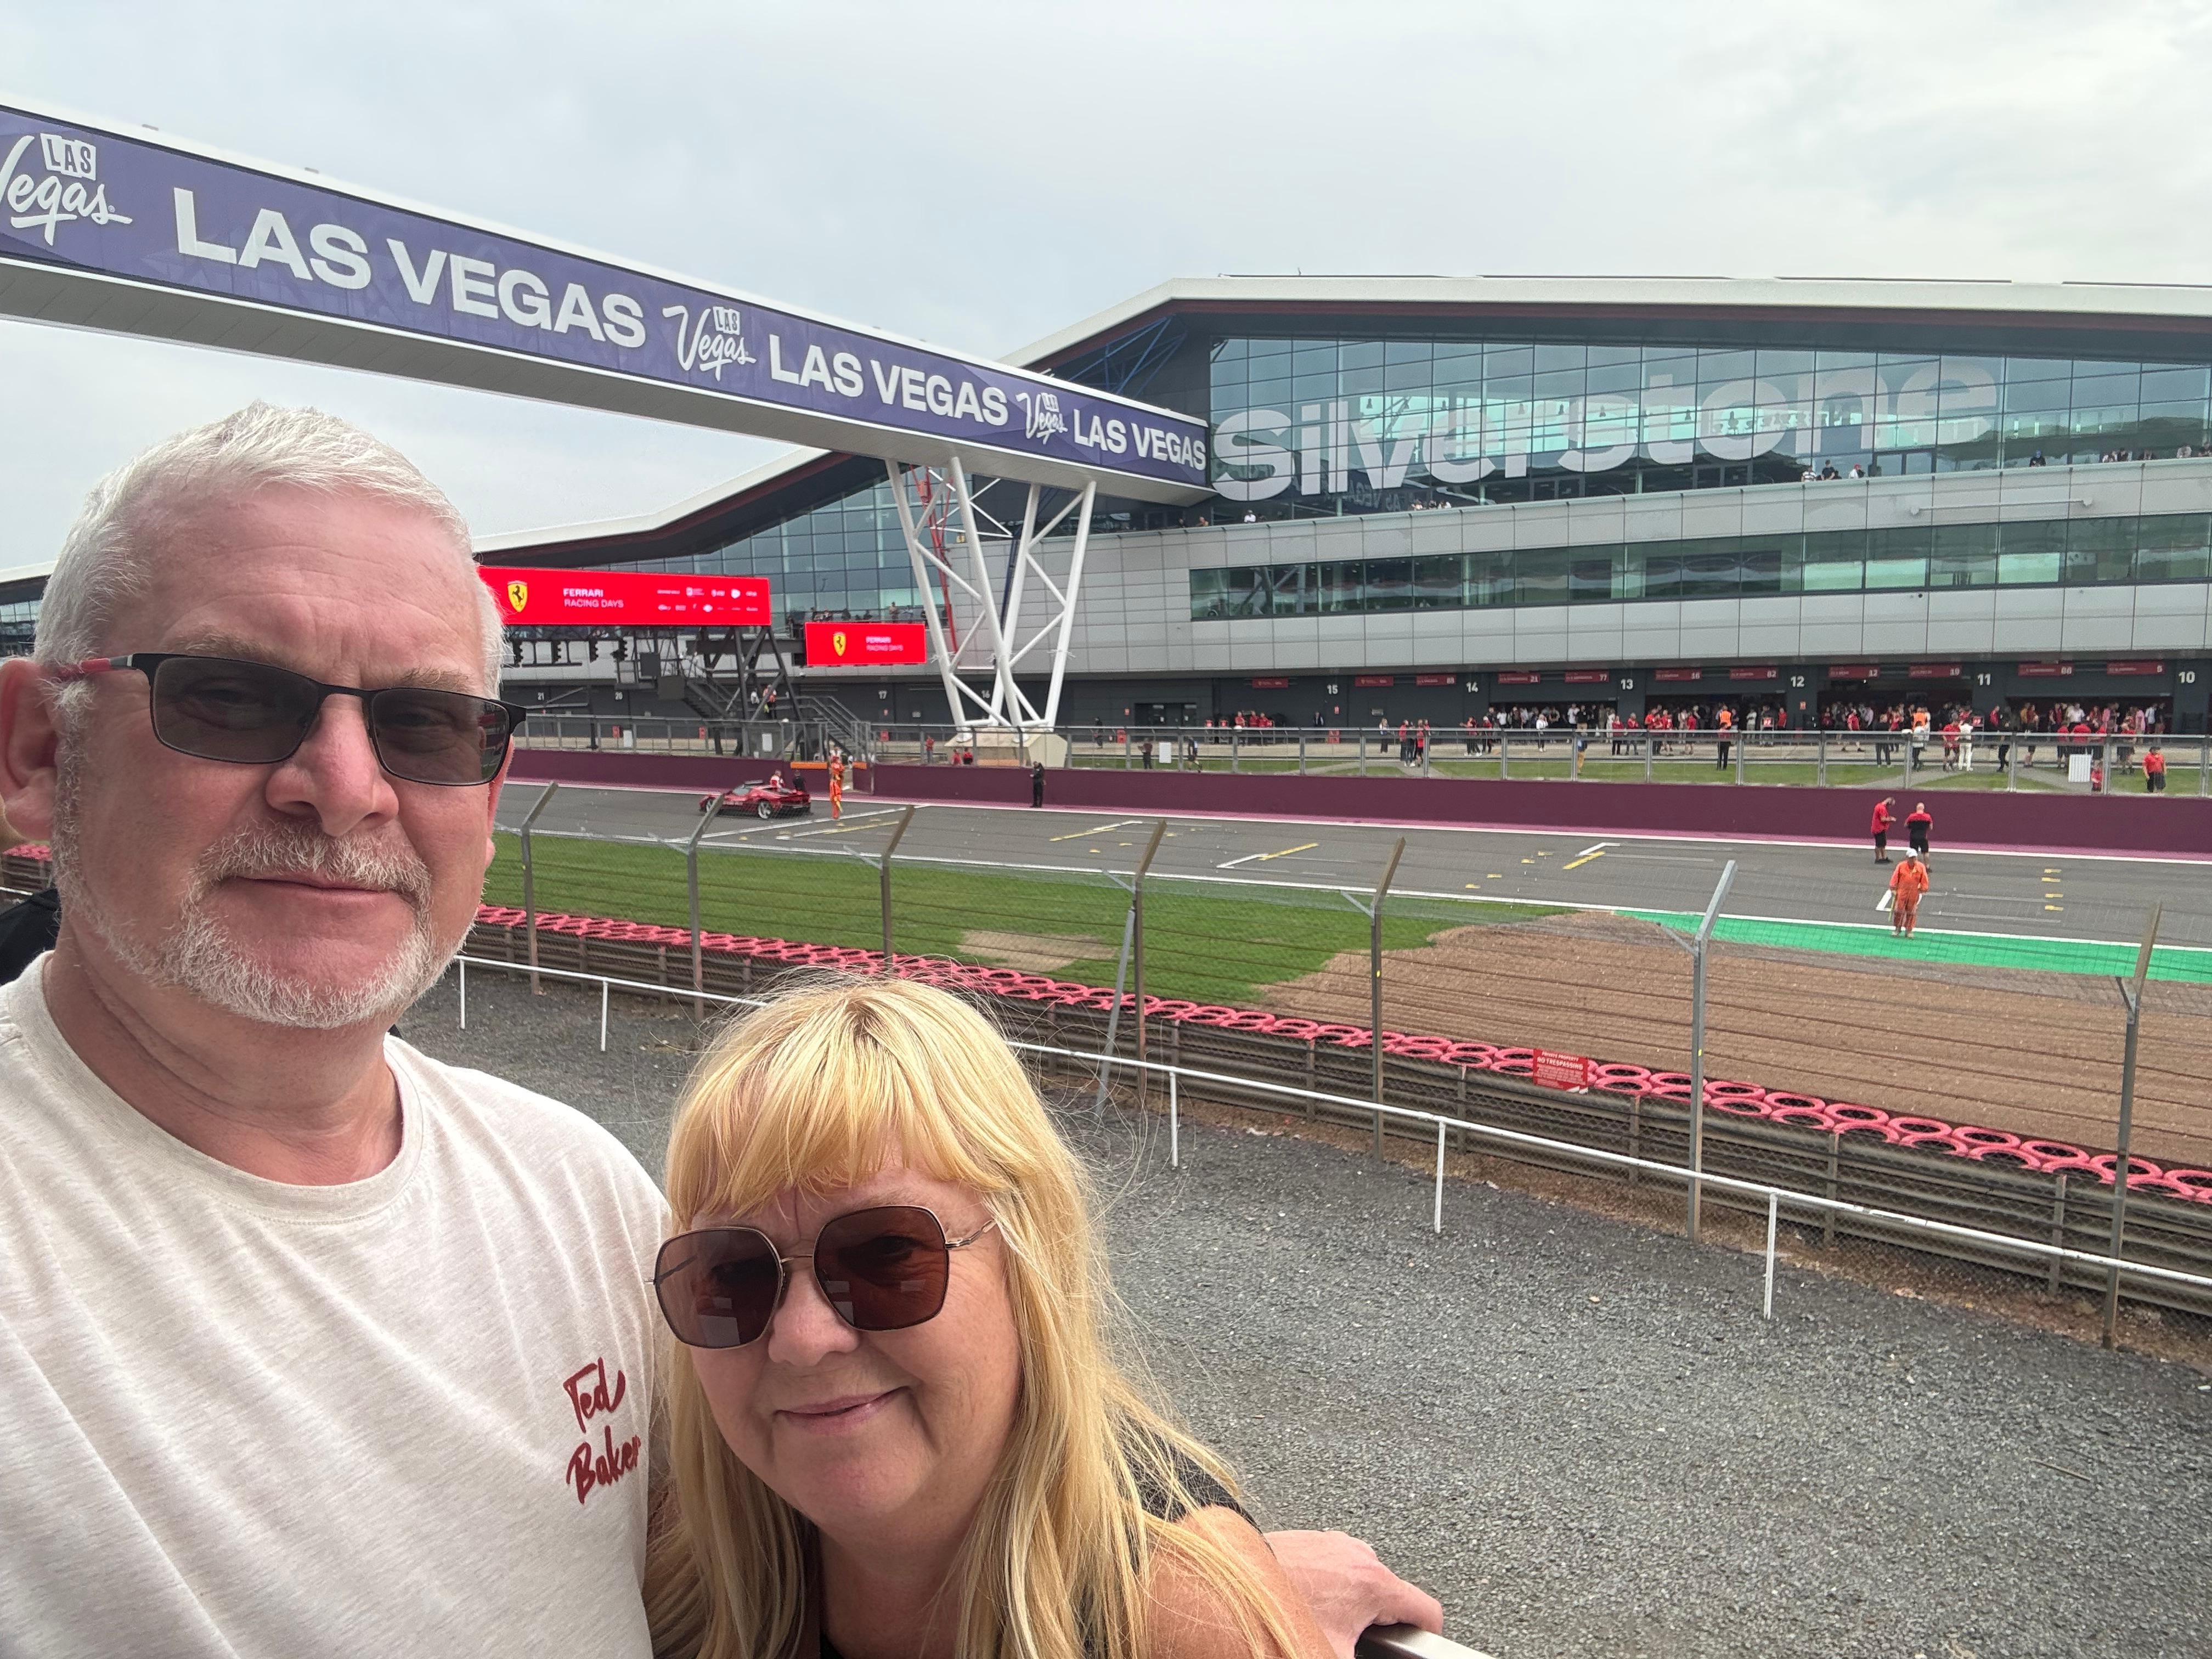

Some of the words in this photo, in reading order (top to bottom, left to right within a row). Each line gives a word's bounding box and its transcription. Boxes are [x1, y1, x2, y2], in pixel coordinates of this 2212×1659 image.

[41, 134, 95, 180] LAS
[173, 187, 372, 290] LAS
[386, 238, 646, 348] VEGAS
[714, 307, 740, 334] LAS
[662, 305, 757, 382] Vegas
[769, 334, 864, 397] LAS
[870, 359, 1009, 426] VEGAS
[1015, 392, 1068, 445] Vegas
[1073, 408, 1127, 454] LAS
[1130, 422, 1206, 471] VEGAS
[563, 588, 603, 597] FERRARI
[564, 599, 599, 607] RACING
[601, 599, 624, 608] DAYS
[1790, 675, 1804, 687] 12
[1977, 673, 1991, 686] 11
[2178, 671, 2196, 684] 10
[1327, 685, 1338, 695] 15
[1466, 681, 1479, 693] 14
[1620, 679, 1633, 690] 13
[537, 692, 544, 701] 21
[878, 690, 887, 699] 17
[1546, 1058, 1583, 1070] TRESPASSING
[563, 1356, 626, 1434] Ted
[566, 1425, 641, 1505] Baker
